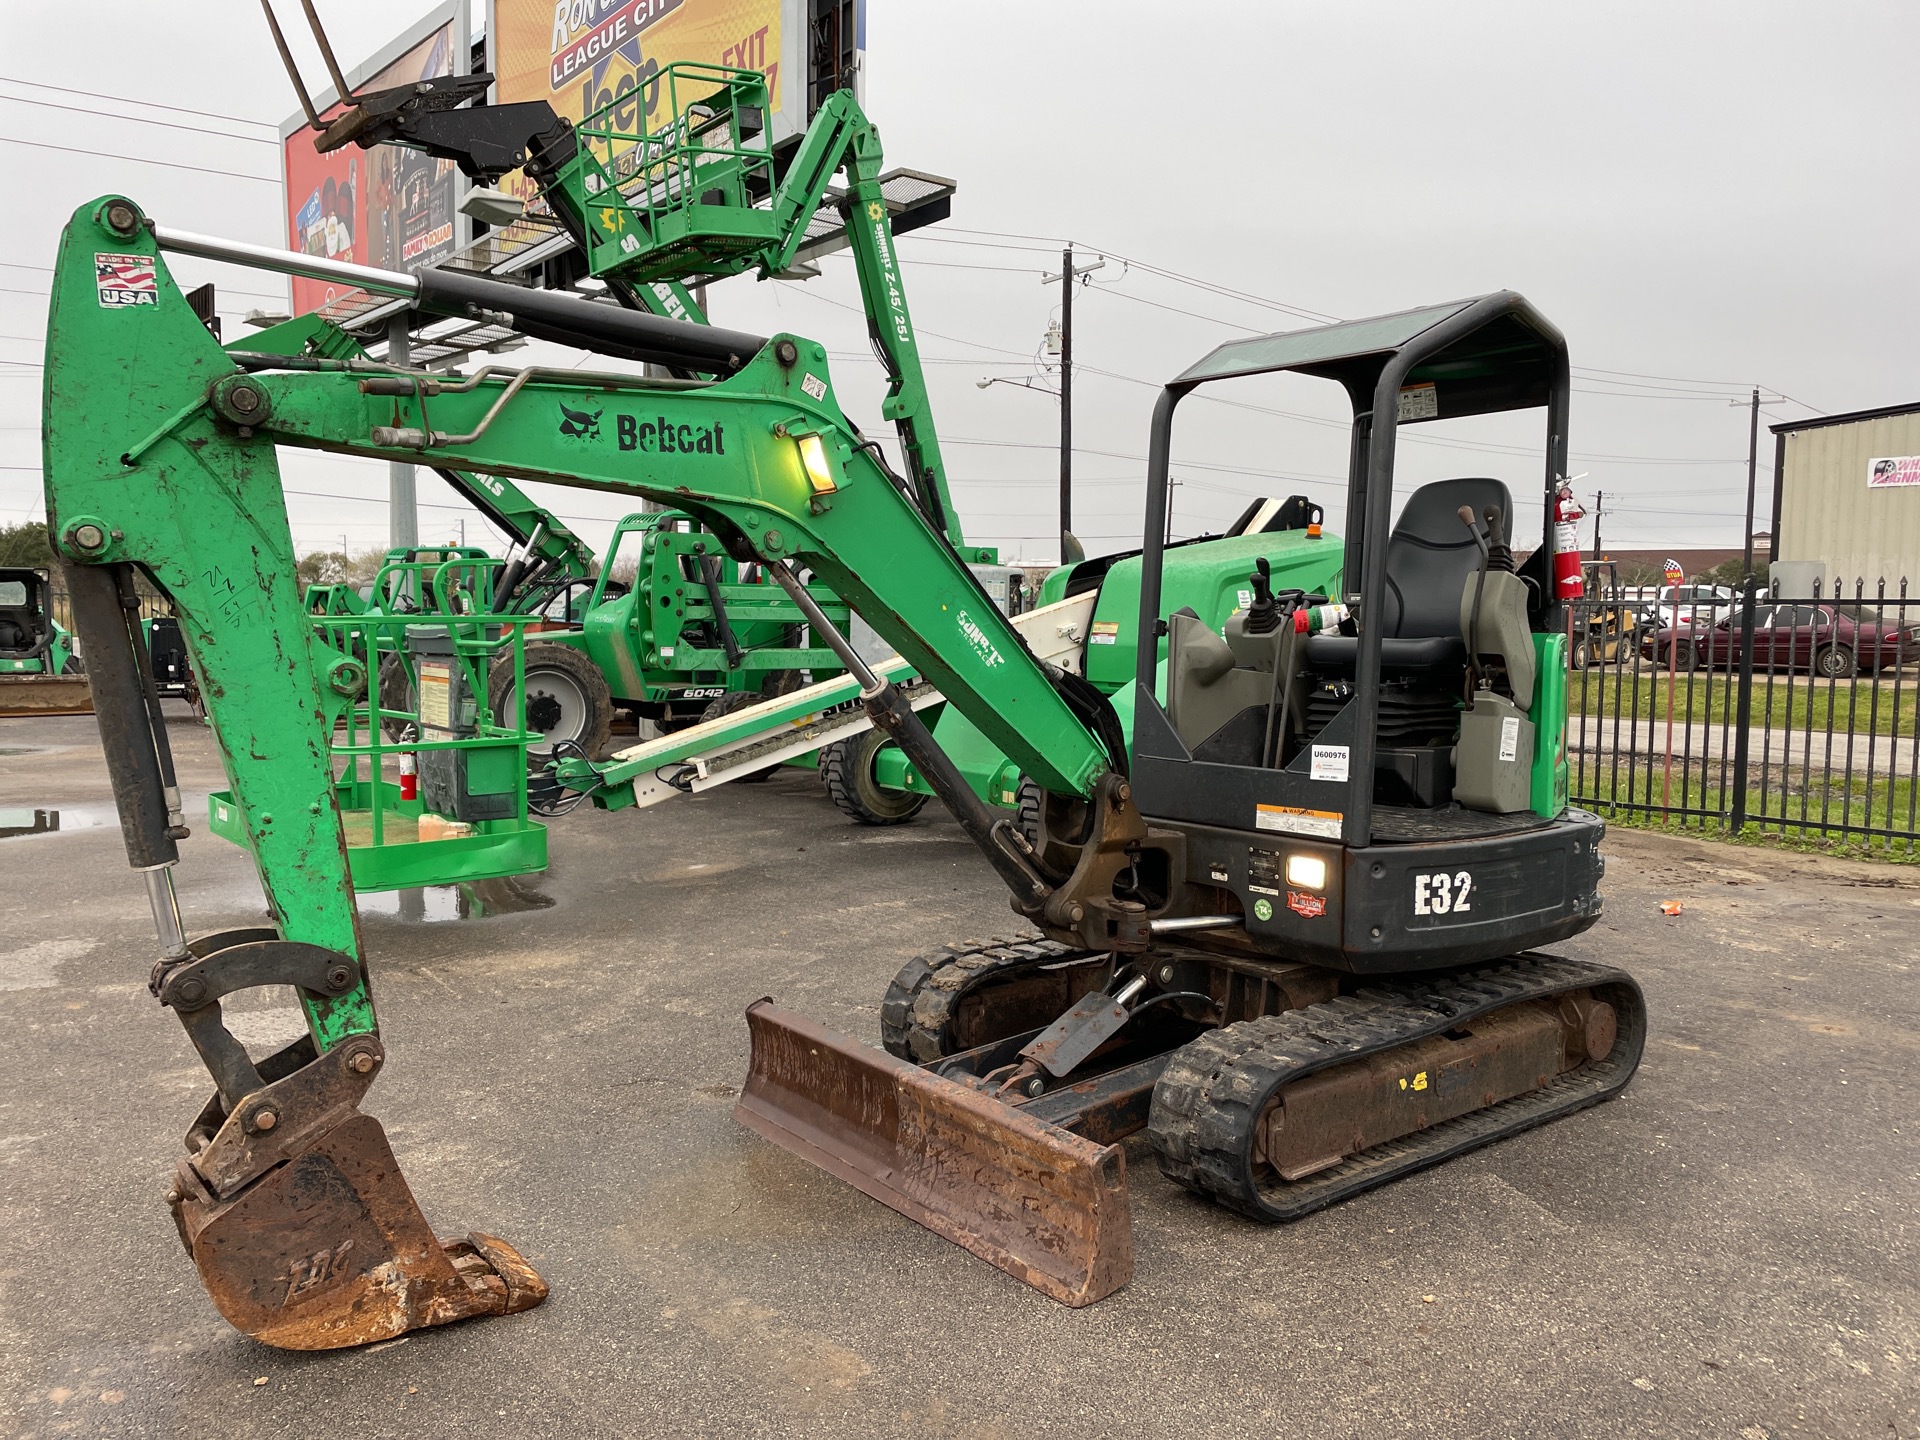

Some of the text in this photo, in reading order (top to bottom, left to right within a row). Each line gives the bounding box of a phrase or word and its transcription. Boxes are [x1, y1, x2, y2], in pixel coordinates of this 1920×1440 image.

[552, 14, 627, 84] LEAGUE
[722, 24, 769, 90] EXIT
[581, 57, 659, 148] Jeep
[306, 201, 317, 218] LED
[875, 222, 893, 269] SUNBELT
[101, 290, 155, 305] USA
[616, 413, 725, 456] Bobcat
[683, 688, 724, 698] 6042
[1314, 750, 1347, 760] U600976
[1289, 807, 1315, 817] WARNING
[1414, 870, 1473, 916] E32
